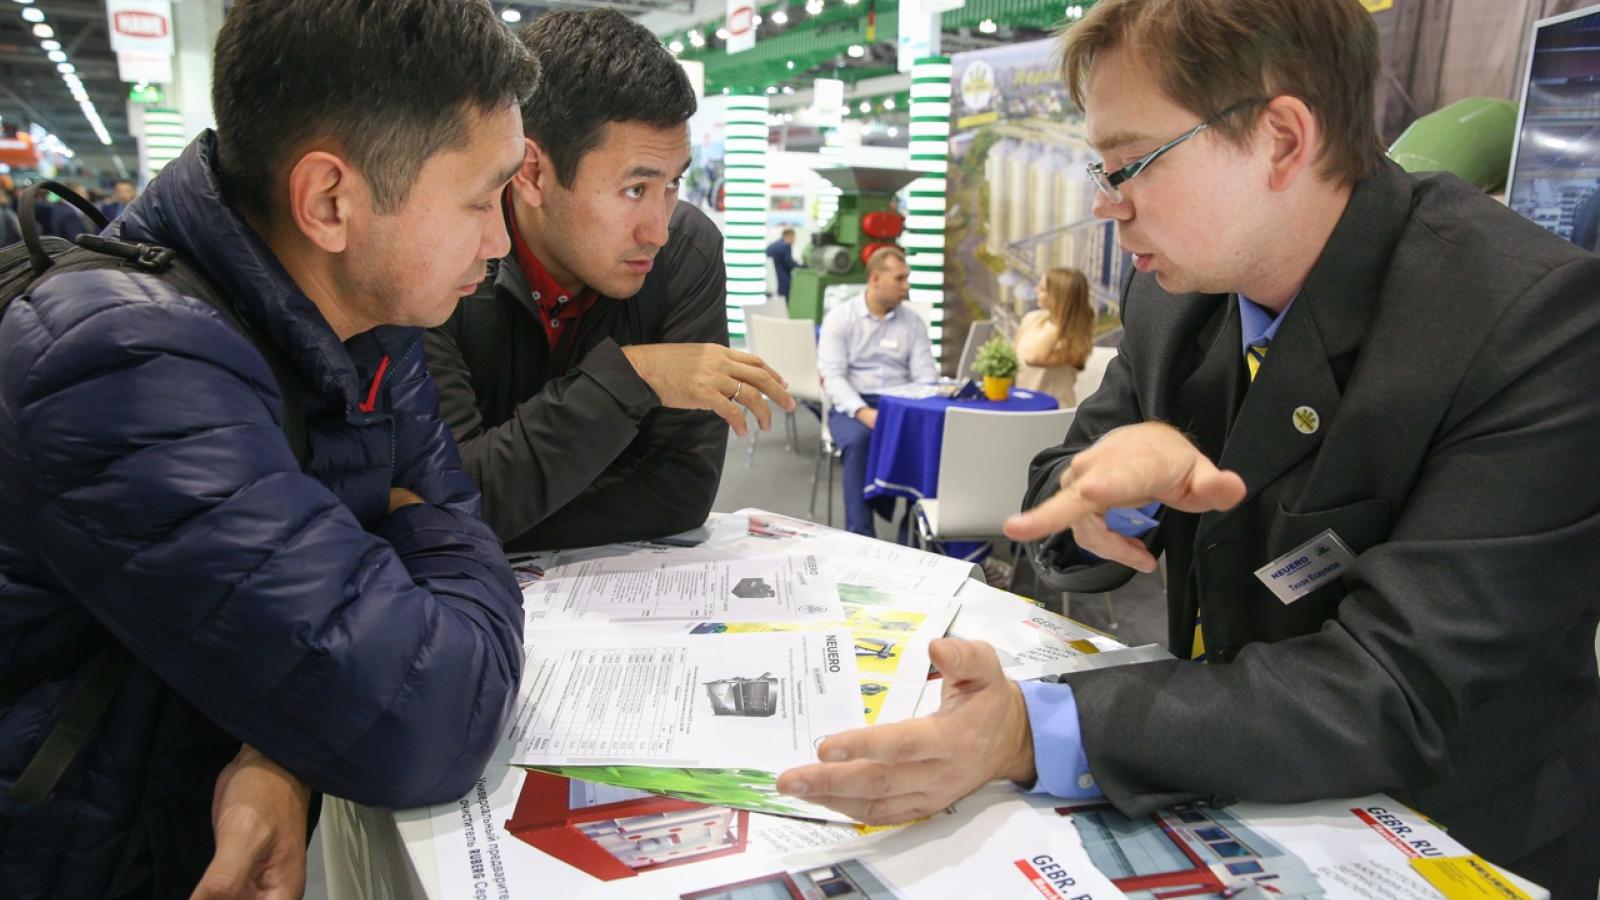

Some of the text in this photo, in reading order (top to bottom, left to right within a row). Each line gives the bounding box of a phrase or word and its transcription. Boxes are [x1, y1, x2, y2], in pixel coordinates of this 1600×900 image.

[1271, 556, 1309, 580] NEUERO
[826, 635, 841, 673] NEUERO
[475, 777, 500, 843] Универсальный
[1367, 806, 1413, 839] GEBR.
[460, 800, 477, 848] очиститель
[469, 848, 486, 880] RUBERG
[1032, 854, 1068, 894] GEBR.
